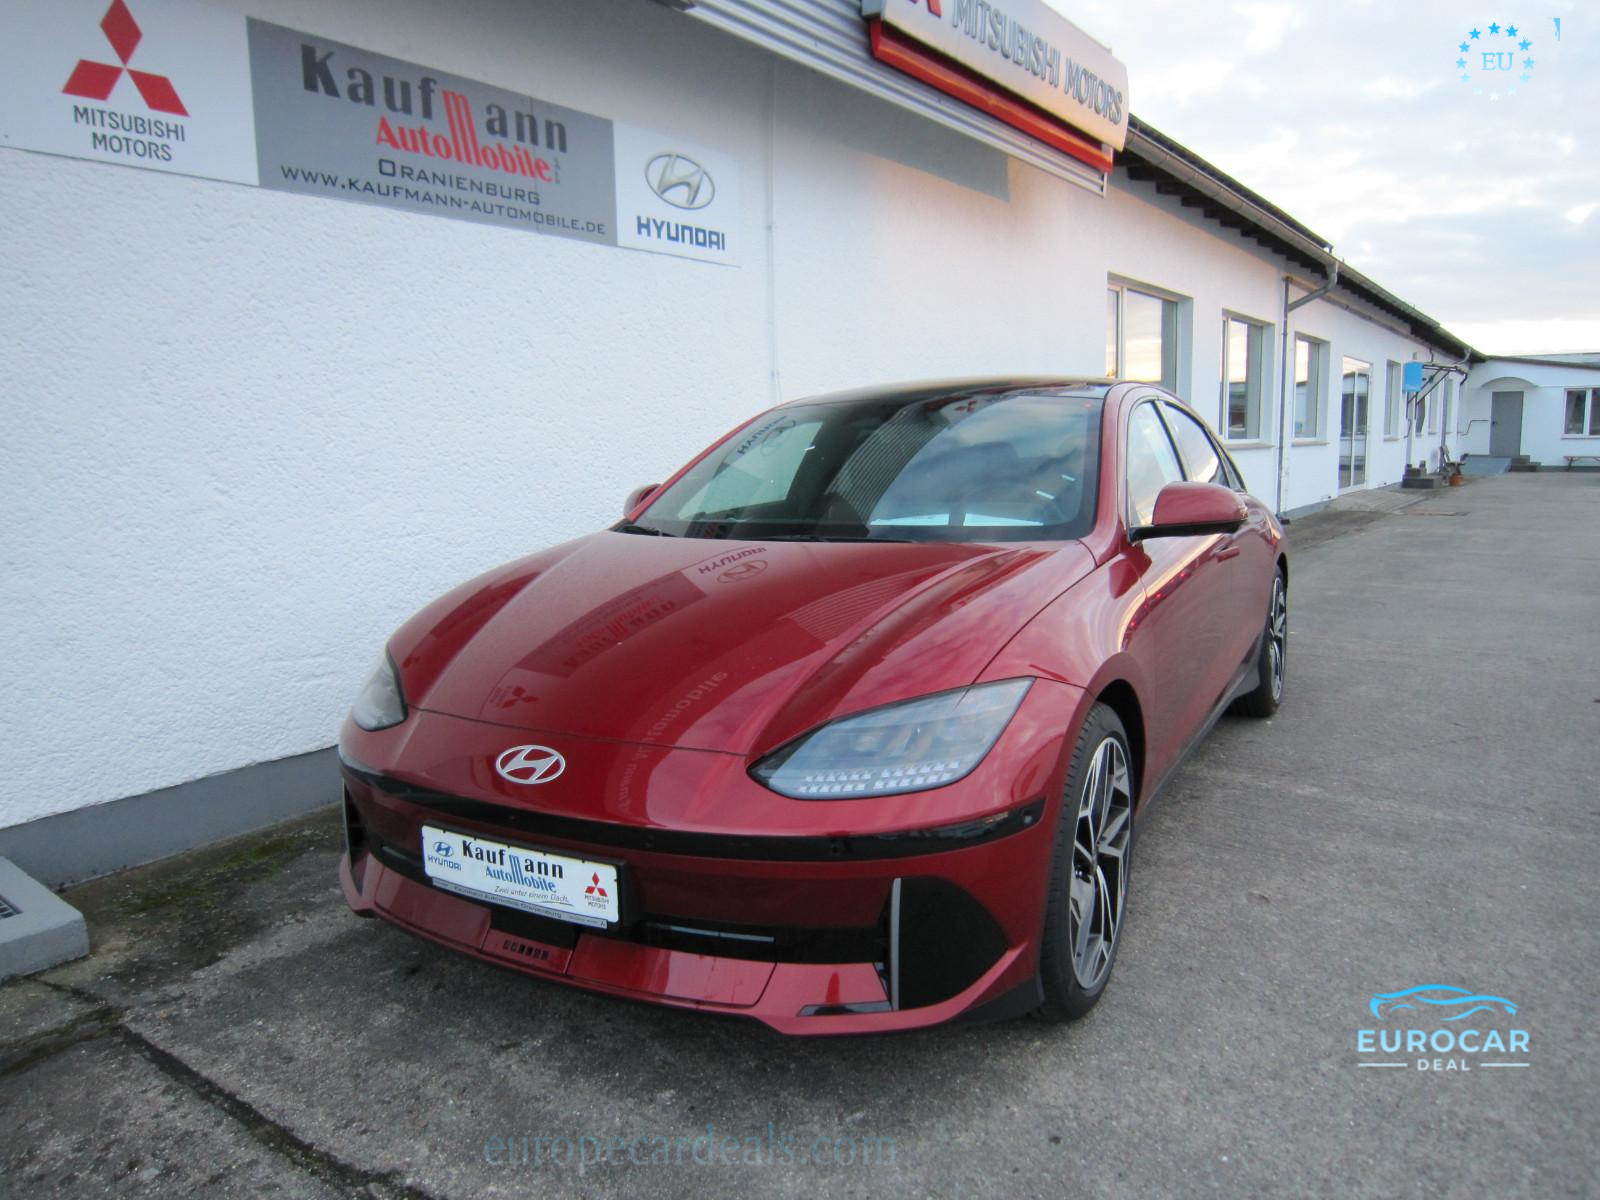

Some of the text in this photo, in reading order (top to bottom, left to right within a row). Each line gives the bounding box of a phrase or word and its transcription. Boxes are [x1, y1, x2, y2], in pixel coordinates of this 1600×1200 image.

[952, 1, 1123, 125] MITSUBISHI MOTORS
[73, 104, 186, 142] MITSUBISHI
[92, 132, 173, 162] MOTORS
[379, 158, 541, 205] ORANIENBURG
[636, 215, 726, 251] HYUNDAI
[427, 855, 462, 871] HYUNDAI
